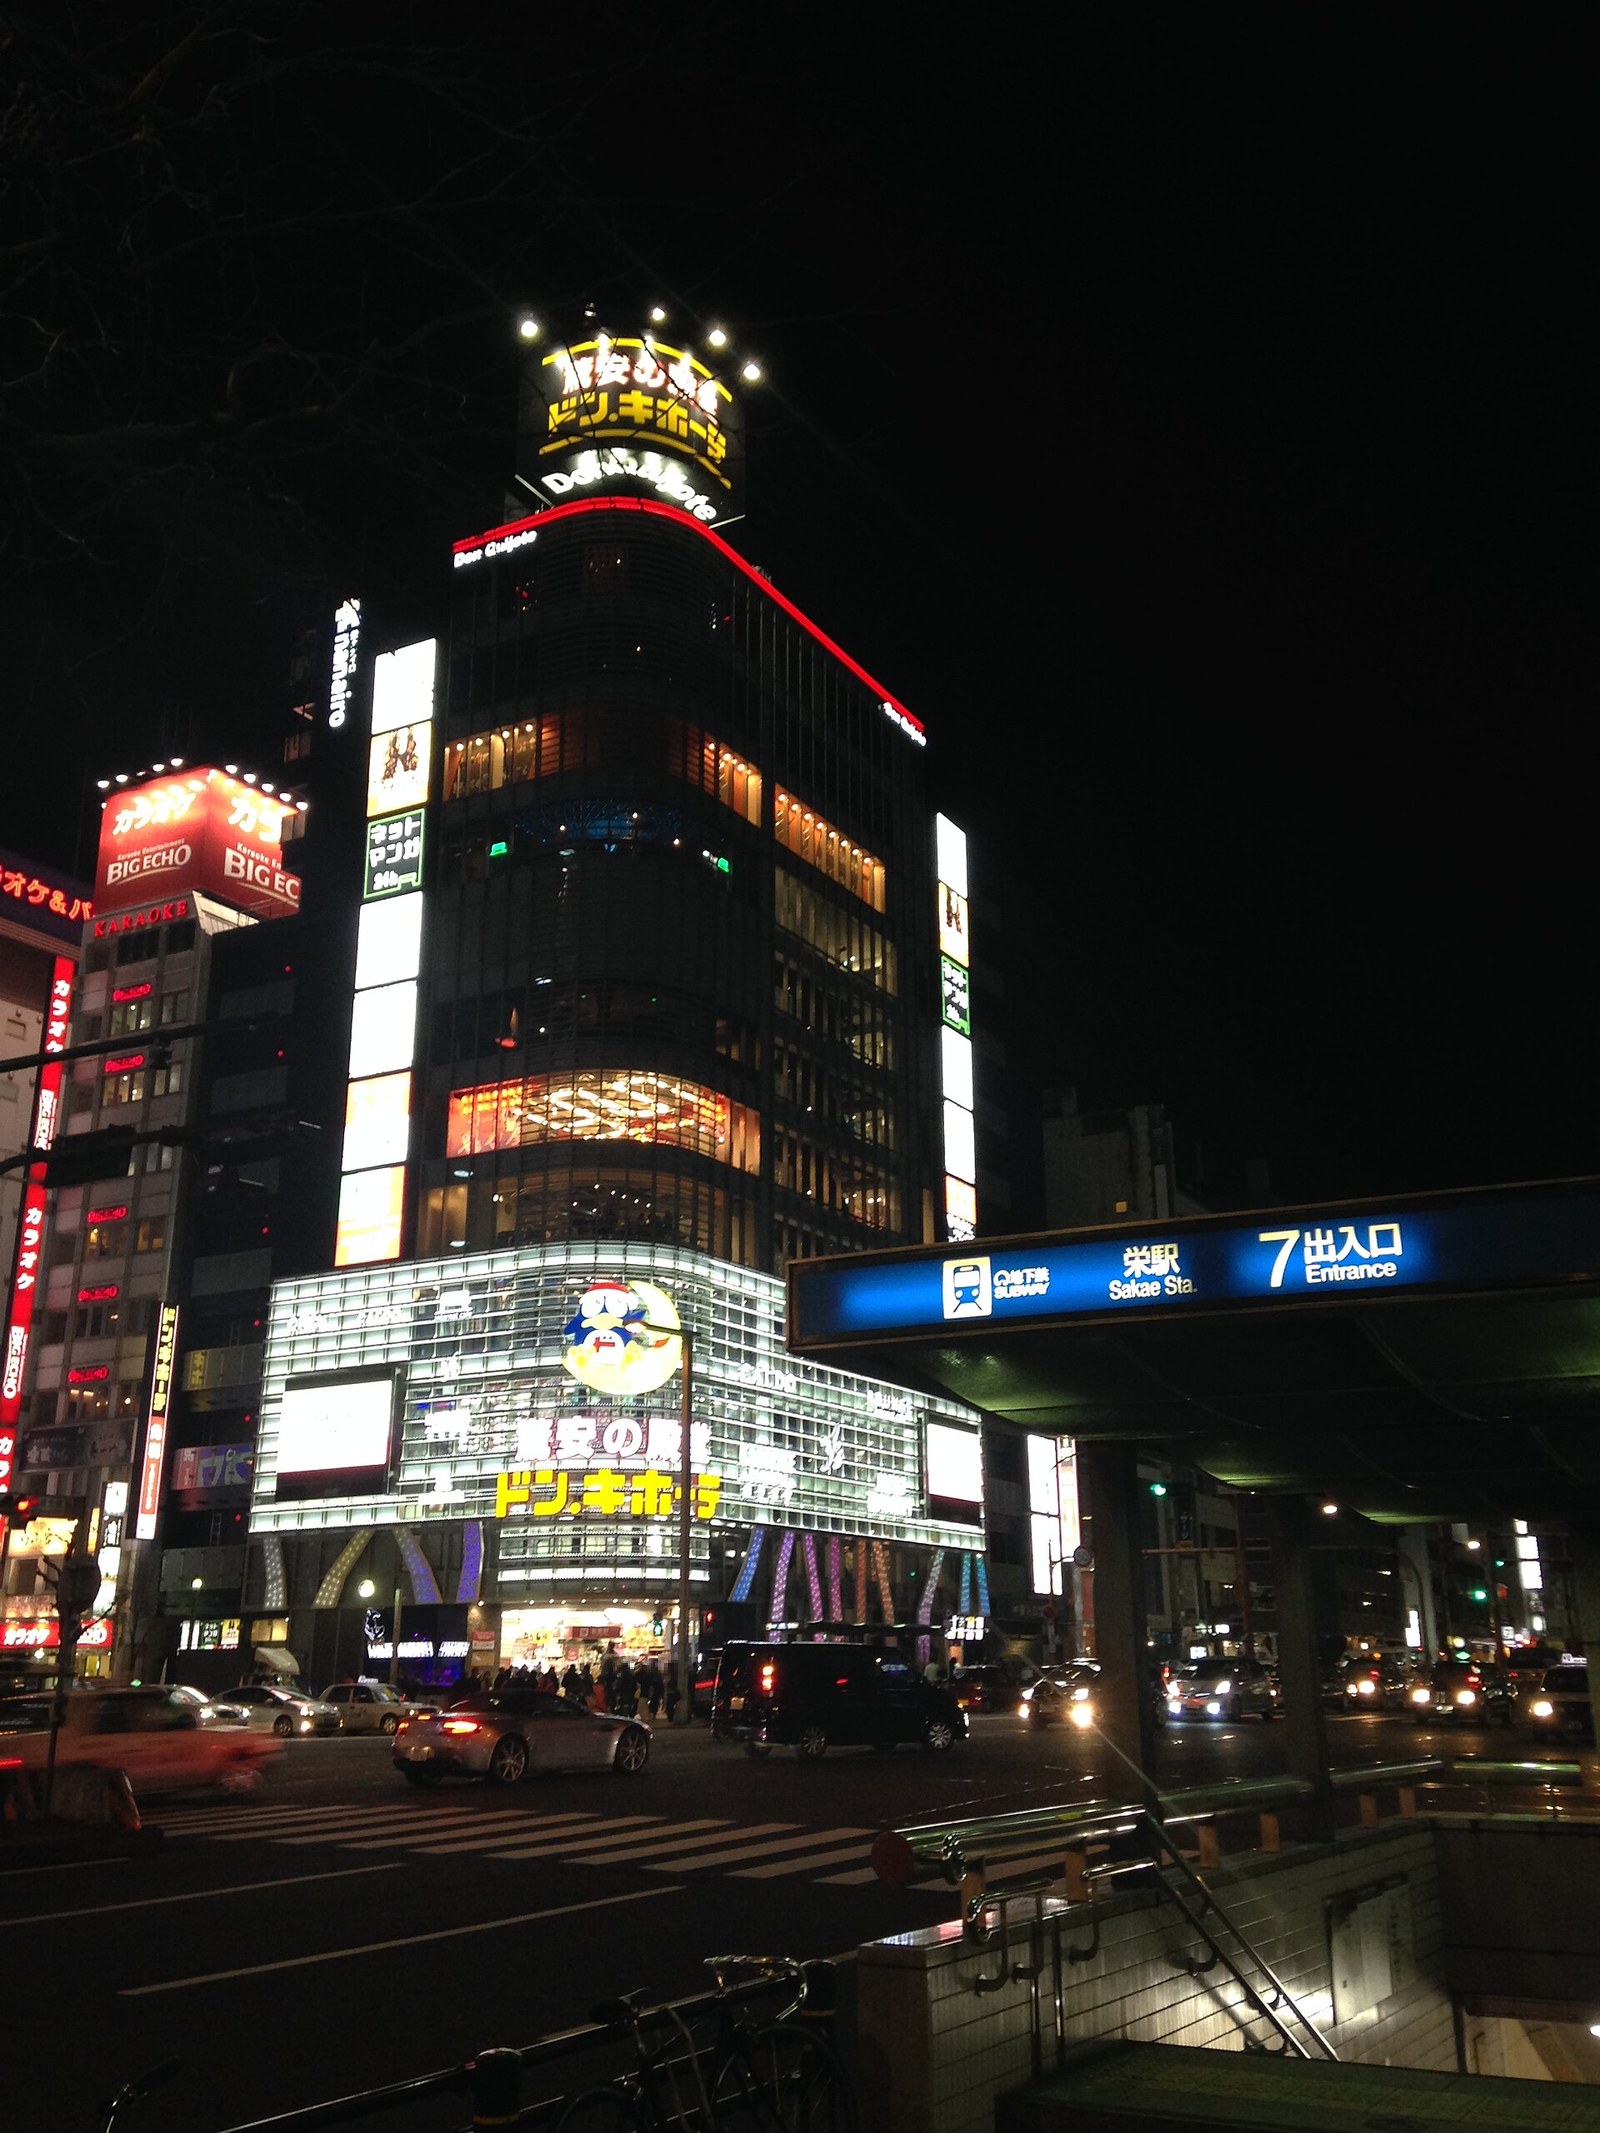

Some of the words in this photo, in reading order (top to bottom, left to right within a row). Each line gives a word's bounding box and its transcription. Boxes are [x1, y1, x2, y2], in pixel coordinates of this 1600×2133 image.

[112, 790, 197, 836] カラオケ
[371, 817, 420, 844] ネット
[107, 860, 140, 886] BIG
[142, 844, 191, 870] ECHO
[237, 842, 270, 866] Karaoke
[369, 836, 420, 867] マンガ
[223, 847, 271, 886] BIG
[275, 873, 300, 900] EC
[93, 901, 189, 938] KARAOKE
[45, 979, 71, 1053] カラオケ
[17, 1208, 43, 1289] カラオケ
[1123, 1243, 1181, 1278] 栄駅
[1258, 1229, 1301, 1289] 7
[1303, 1223, 1404, 1265] 出入口
[994, 1282, 1050, 1299] SUBWAY
[1009, 1267, 1050, 1286] 地下鉄
[1109, 1279, 1161, 1301] Sakae
[1164, 1275, 1198, 1296] Sta.
[1305, 1261, 1398, 1285] Entrance
